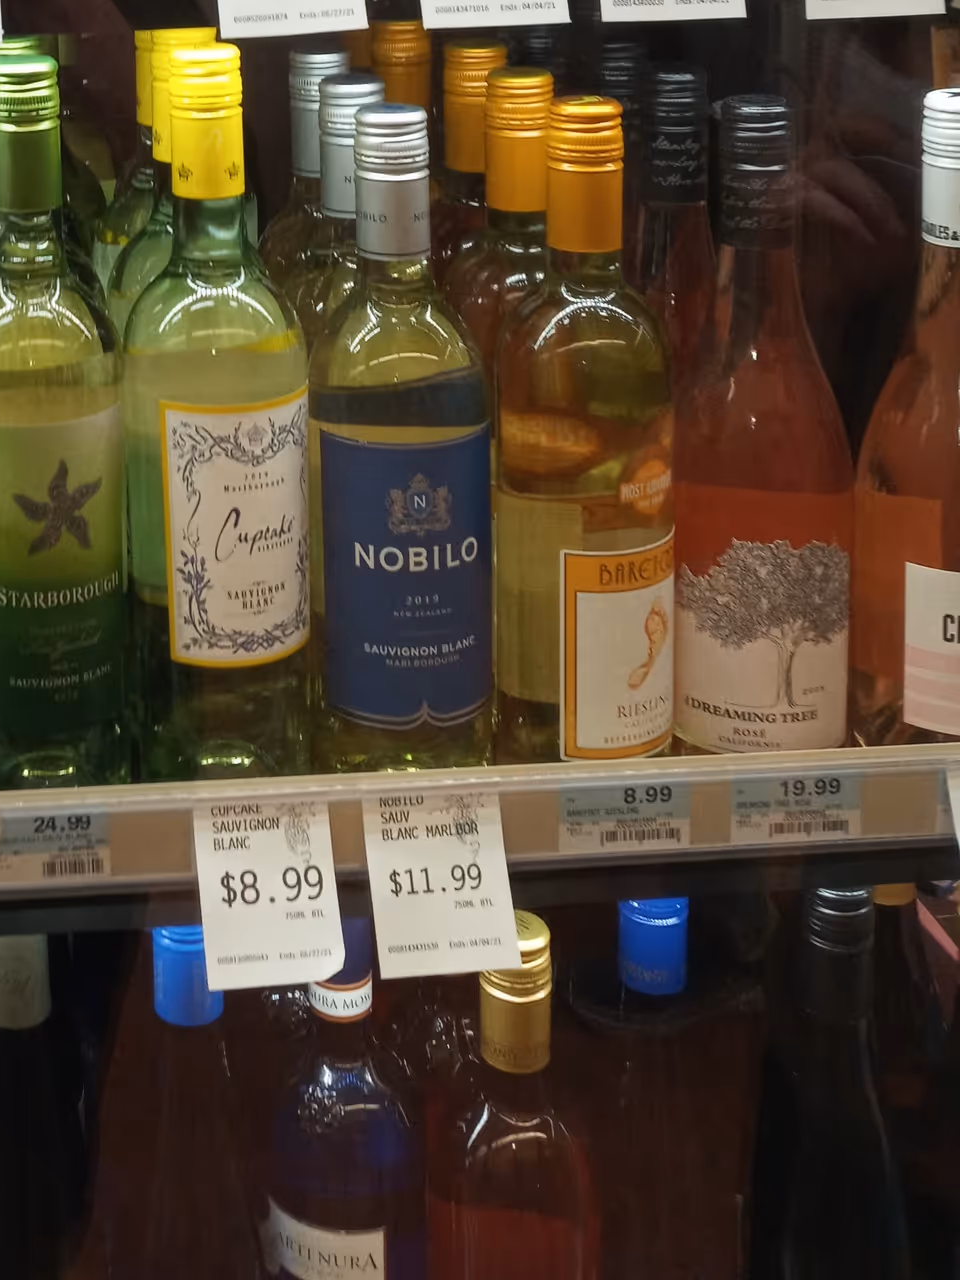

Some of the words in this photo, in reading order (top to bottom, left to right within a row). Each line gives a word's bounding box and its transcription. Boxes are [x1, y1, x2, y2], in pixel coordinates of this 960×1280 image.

[414, 495, 426, 509] N
[215, 507, 295, 561] Cupcake
[353, 536, 479, 572] NOBILO
[227, 581, 286, 601] SAUVIGNON
[406, 593, 439, 606] 2019
[364, 642, 438, 657] SAUVIGNON
[442, 635, 477, 654] BLANC
[690, 698, 777, 724] DREAMING
[780, 710, 819, 723] TREE
[624, 785, 673, 804] 8.99
[780, 778, 841, 797] 19.99
[211, 803, 262, 816] CUPCAKE
[379, 795, 424, 808] NOBILO
[33, 815, 91, 834] 24.99
[212, 817, 280, 833] SAUVIGNON
[380, 810, 410, 824] SAUV
[213, 836, 251, 851] BLANC
[381, 827, 419, 841] BLANC
[220, 865, 324, 908] $8.99
[389, 863, 482, 897] $11.99
